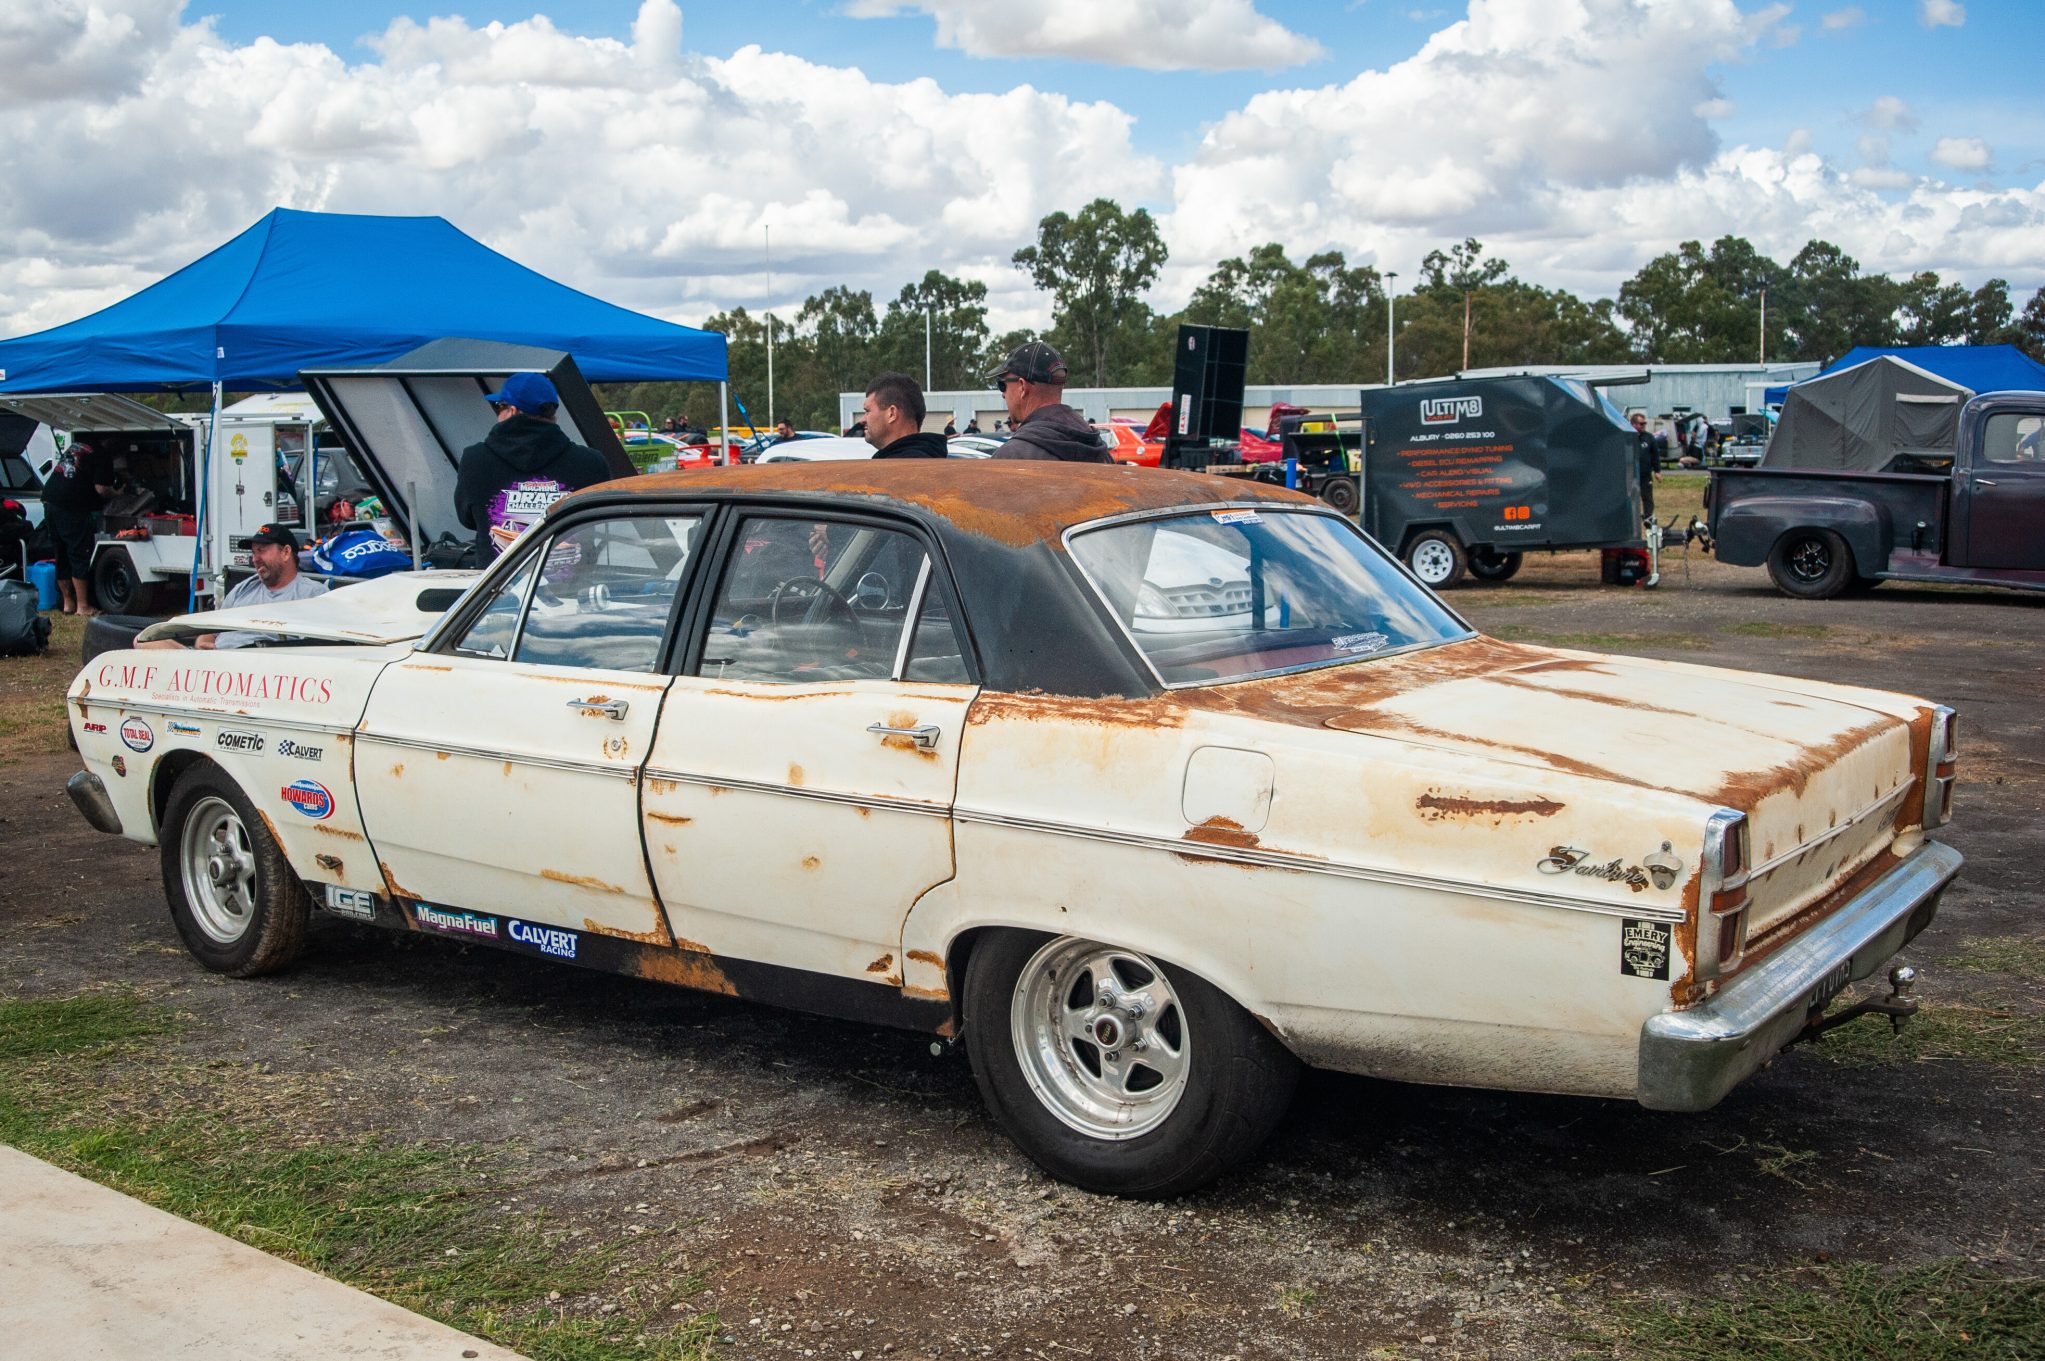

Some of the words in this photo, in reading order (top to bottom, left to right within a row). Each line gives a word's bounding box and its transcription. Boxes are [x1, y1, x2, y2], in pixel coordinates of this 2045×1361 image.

[1424, 398, 1480, 417] ULTIM8
[1410, 433, 1440, 442] ALBURY
[1444, 432, 1465, 440] 0260
[1466, 431, 1482, 439] 253
[1482, 431, 1496, 439] 100
[99, 665, 158, 690] G.M.F
[167, 668, 332, 705] AUTOMATICS
[190, 694, 217, 705] Automatic
[220, 697, 260, 709] Transmissions
[84, 722, 106, 732] ARP
[123, 727, 138, 739] TOTAL
[139, 729, 151, 741] SEAL
[218, 732, 264, 751] COMETIC
[289, 741, 323, 759] CALVERT
[281, 786, 325, 808] HOWARDS
[417, 905, 496, 935] MagnaFuel
[507, 919, 577, 951] CALVERT
[1626, 928, 1666, 942] EMERY
[540, 944, 576, 958] RACING
[1623, 938, 1666, 954] Engineering
